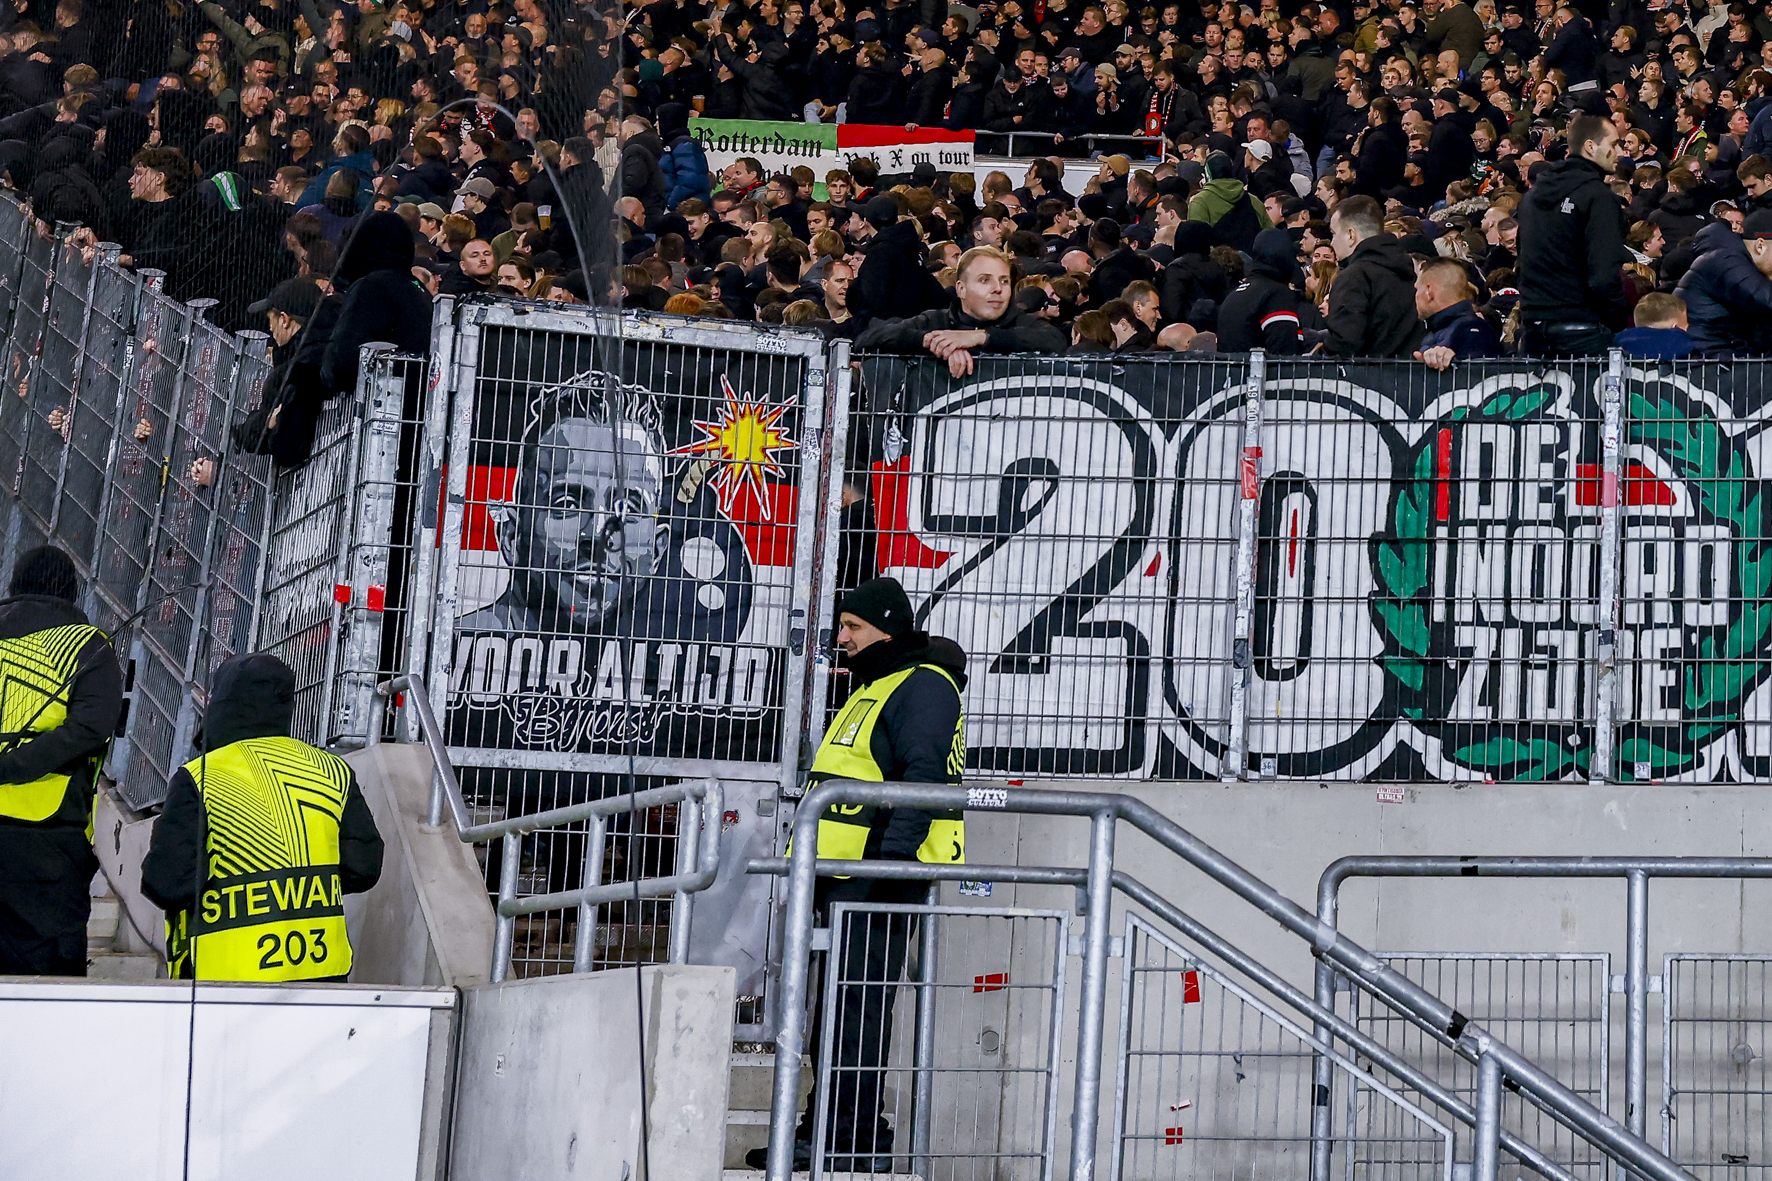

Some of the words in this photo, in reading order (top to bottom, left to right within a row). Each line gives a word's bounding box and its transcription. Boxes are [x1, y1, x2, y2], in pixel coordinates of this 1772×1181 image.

[694, 126, 823, 159] Rotterdam
[938, 150, 971, 167] tour
[756, 336, 787, 348] SOTTO
[1458, 422, 1573, 521] DE
[1453, 524, 1731, 625] NOORD
[449, 634, 583, 705] VOOR
[595, 638, 770, 715] ALTIJD
[1447, 624, 1681, 728] ZIJDE
[966, 788, 1008, 800] SOTTO
[201, 874, 344, 924] STEWAR
[256, 928, 328, 970] 203
